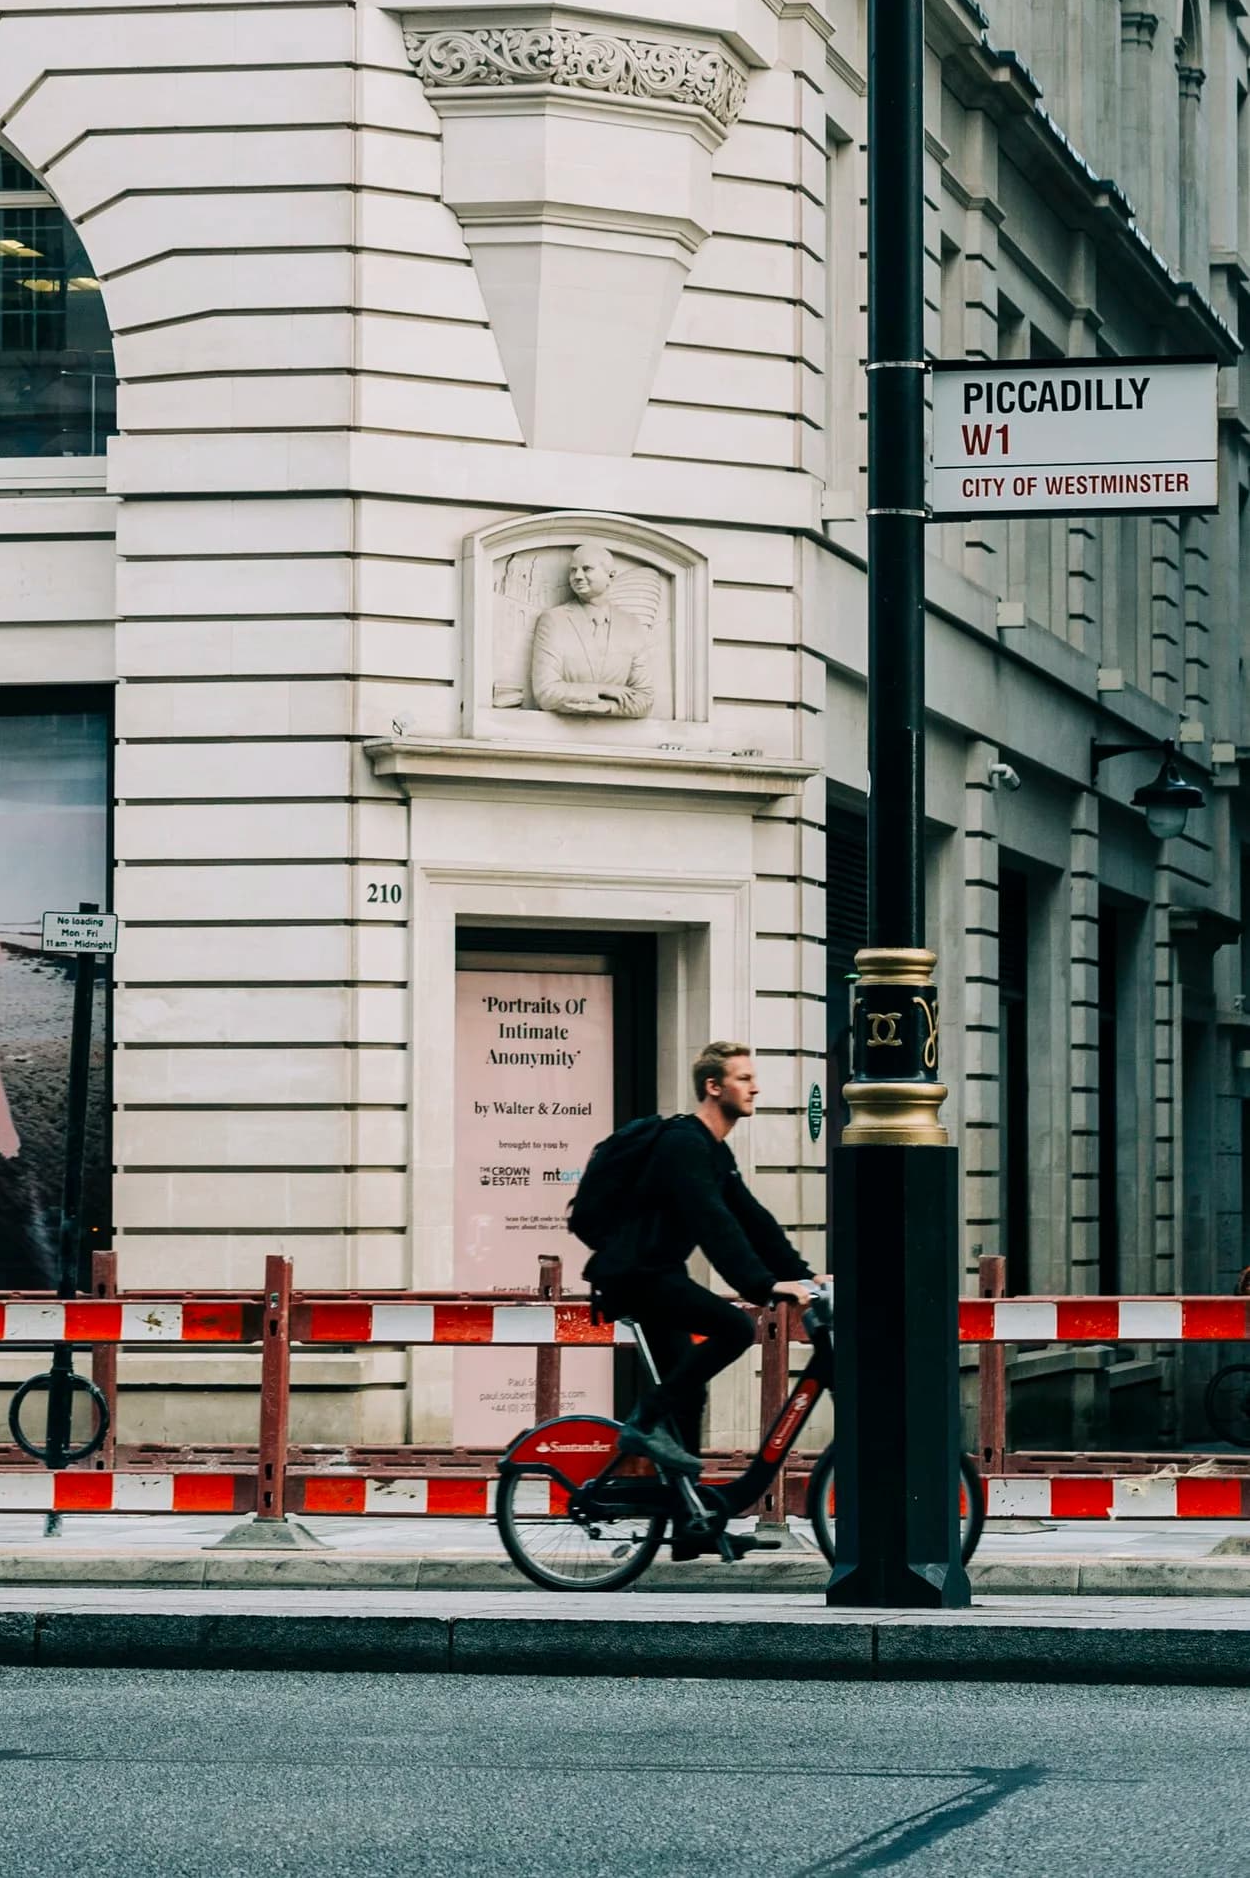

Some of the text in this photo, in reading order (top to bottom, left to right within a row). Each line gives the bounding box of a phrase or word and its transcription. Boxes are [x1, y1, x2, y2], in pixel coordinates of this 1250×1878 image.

[963, 377, 1150, 414] PICCADILLY
[962, 424, 1010, 456] W1
[962, 473, 1190, 497] CITY OF WESTMINSTER
[367, 883, 402, 903] 210
[57, 917, 104, 928] No loading
[61, 929, 80, 937] Mon
[86, 929, 99, 938] Fri
[74, 940, 112, 950] Midnight
[565, 997, 587, 1015] Of
[499, 1022, 569, 1040] Intimate
[474, 1101, 592, 1118] by Walter & Zoniel
[499, 1140, 569, 1152] brought to you by
[491, 1166, 530, 1176] CROWN
[492, 1176, 530, 1187] ESTATE
[508, 1378, 527, 1387] Paul
[550, 1440, 612, 1453] Santander
